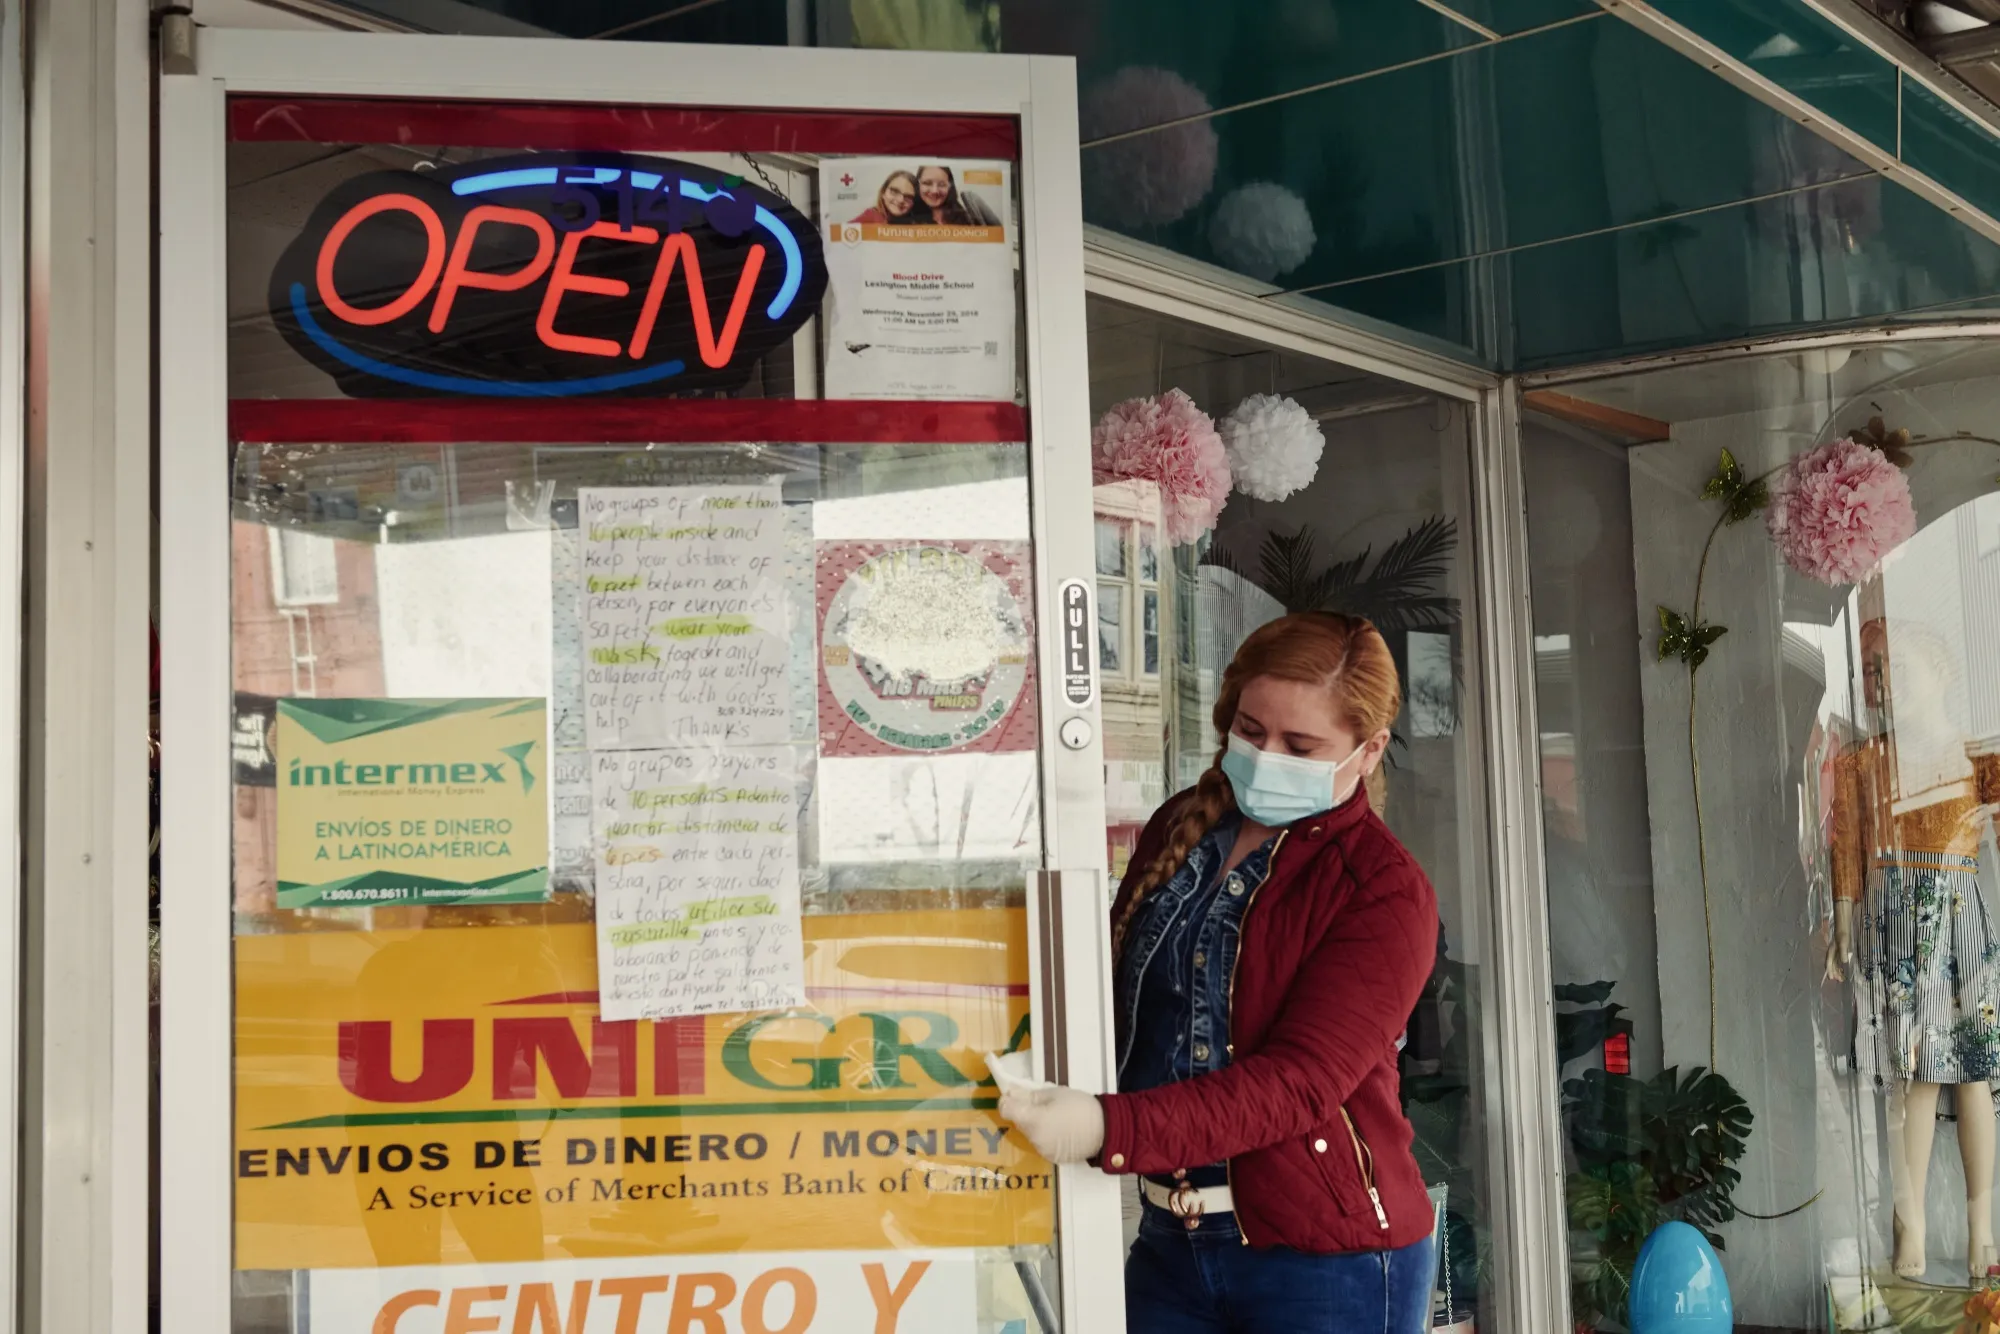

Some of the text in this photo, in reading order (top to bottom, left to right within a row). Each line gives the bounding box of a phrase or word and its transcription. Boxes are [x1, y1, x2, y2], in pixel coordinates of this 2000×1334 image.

[549, 165, 684, 235] 514
[877, 227, 989, 239] FUTURE BLOOD DONOR
[316, 192, 766, 369] OPEN
[865, 281, 974, 290] Lexington Middle School
[892, 273, 944, 281] Blood Drive
[905, 317, 916, 325] AM
[907, 310, 944, 318] November
[585, 494, 604, 513] No
[609, 497, 659, 518] groups
[700, 496, 741, 511] more
[745, 490, 779, 510] than
[590, 513, 763, 551] 10 people inside and
[636, 553, 666, 574] your
[587, 574, 599, 594] 6
[604, 574, 638, 599] feet
[713, 574, 748, 592] each
[645, 599, 674, 625] for
[665, 624, 706, 636] wear
[1068, 585, 1085, 671] PULL
[725, 639, 763, 660] and
[699, 664, 717, 679] we
[724, 660, 756, 679] will
[761, 663, 785, 689] get
[590, 685, 617, 708] out
[678, 682, 716, 704] with
[933, 696, 979, 709] PINLESS
[596, 709, 630, 740] help
[290, 756, 506, 787] intermex
[599, 757, 618, 773] No
[620, 755, 693, 791] grupos
[338, 786, 486, 798] International Money Express
[600, 786, 617, 811] de
[632, 790, 647, 810] 10
[653, 787, 728, 817] personas
[315, 816, 512, 838] ENVÍOS DE DINERO
[677, 811, 758, 834] distancia
[768, 812, 787, 833] de
[315, 836, 511, 861] A LATINOAMÉRICA
[605, 846, 616, 866] 6
[622, 847, 660, 874] pies
[672, 841, 709, 862] entre
[717, 840, 753, 861] cada
[320, 888, 409, 901] 1.800.670.8611
[656, 874, 686, 900] por
[697, 869, 782, 901] seguridad
[610, 897, 777, 924] de todos utilice su
[754, 926, 767, 945] y
[613, 943, 681, 967] laborando
[688, 939, 756, 975] poniendo
[667, 962, 704, 989] parte
[239, 1141, 449, 1179] ENVIOS
[474, 1139, 540, 1171] DE
[567, 1130, 769, 1168] DINERO
[824, 1126, 1010, 1159] MONEY
[366, 1183, 394, 1210] A
[407, 1178, 532, 1208] Service
[545, 1175, 577, 1204] of
[590, 1170, 769, 1202] Merchants
[782, 1168, 866, 1198] Bank
[878, 1166, 913, 1194] of
[371, 1260, 933, 1334] CENTRO Y
